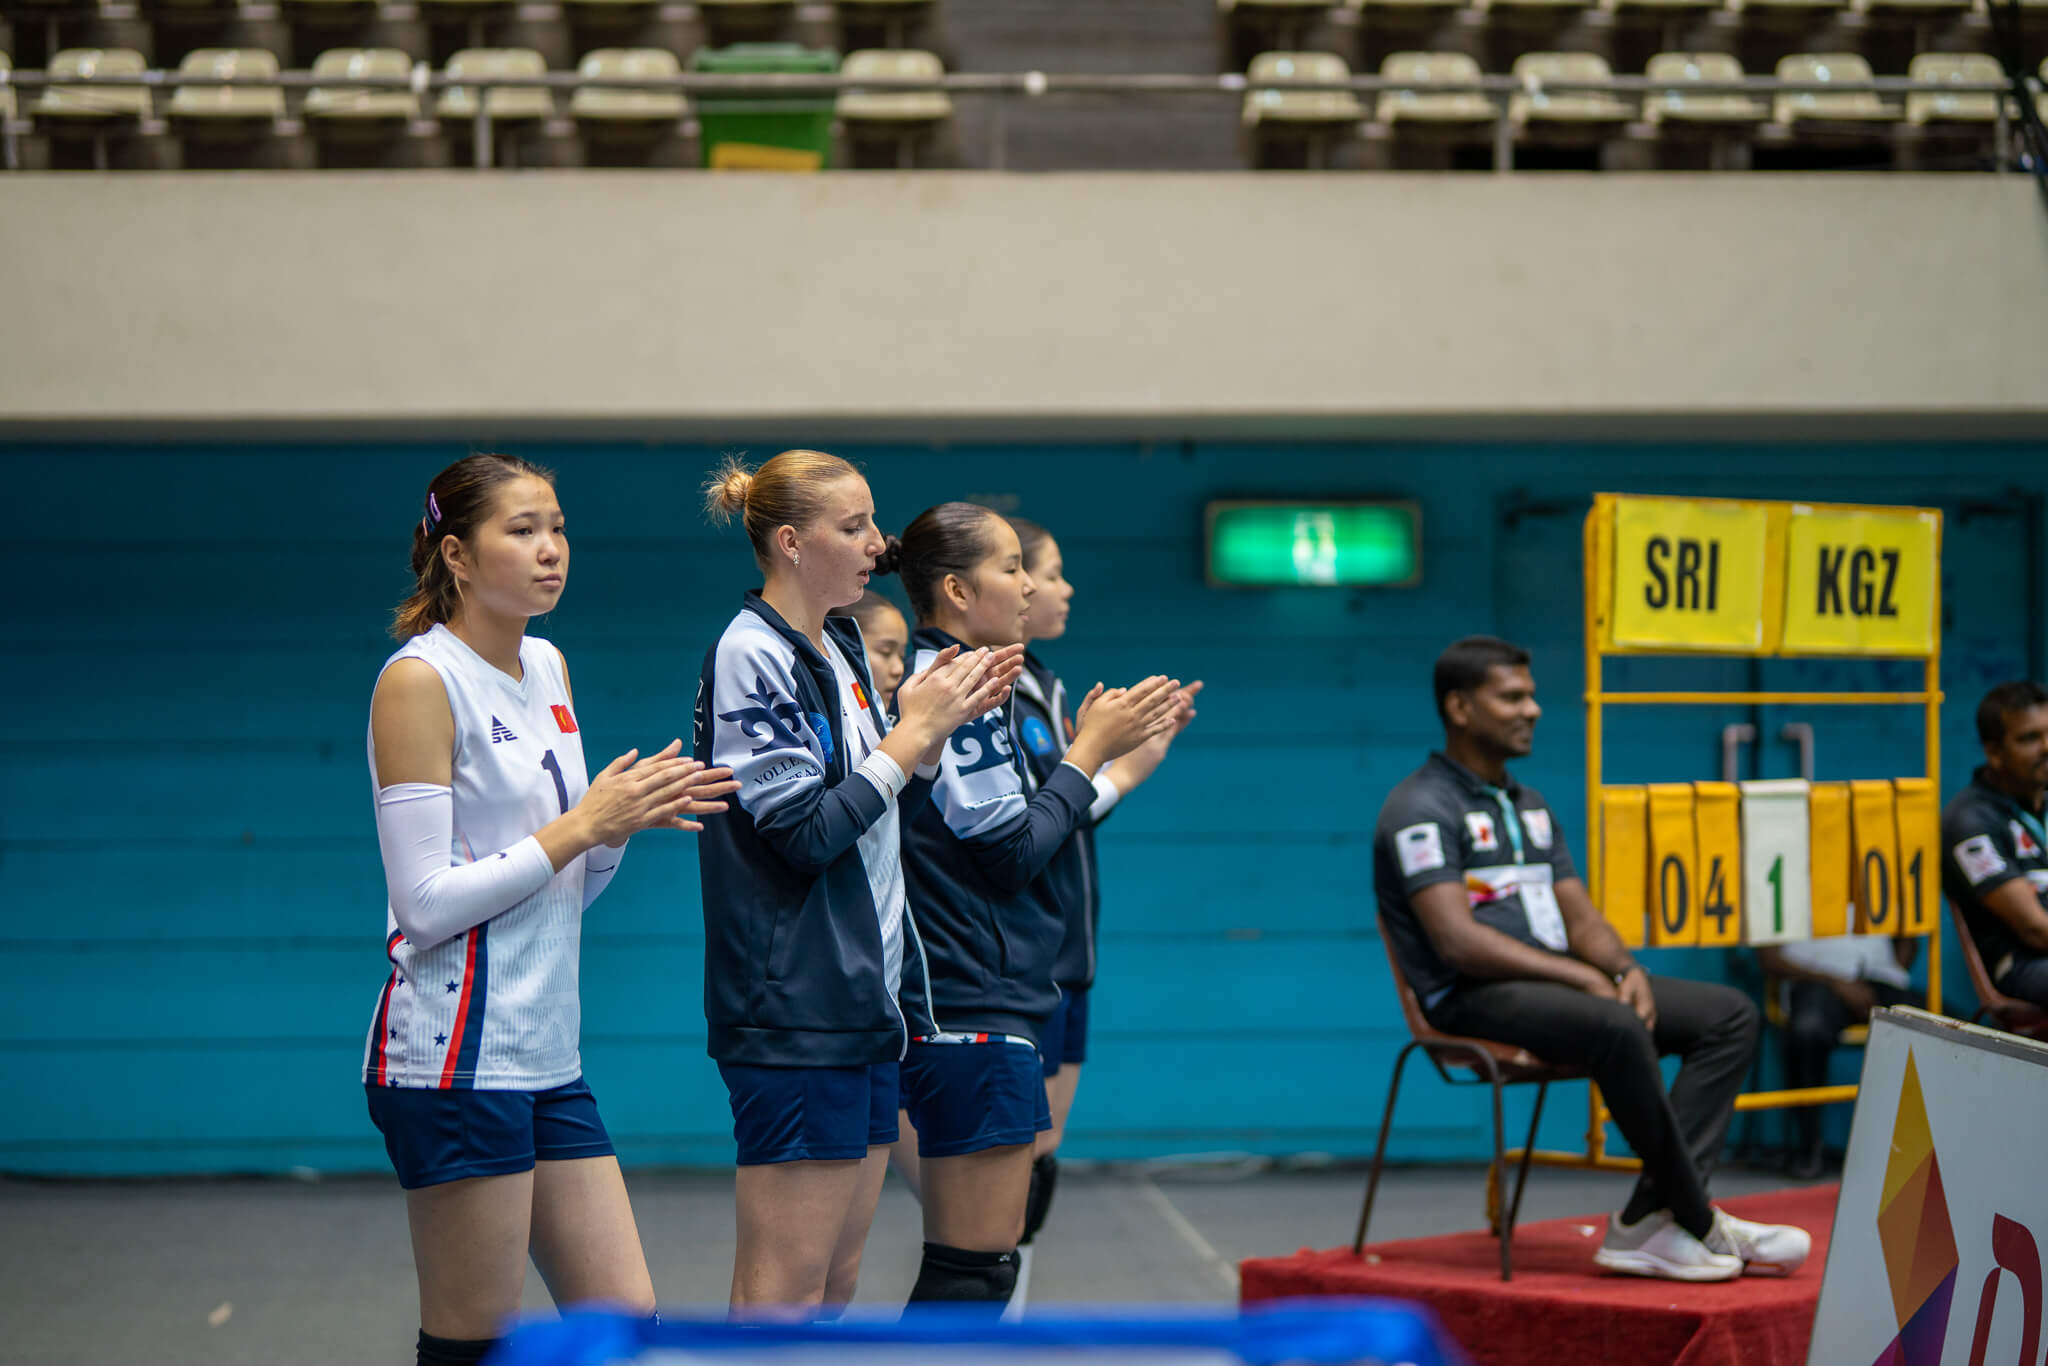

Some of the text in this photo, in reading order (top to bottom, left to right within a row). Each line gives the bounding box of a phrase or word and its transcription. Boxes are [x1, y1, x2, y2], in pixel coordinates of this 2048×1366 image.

[1645, 534, 1720, 611] SRI
[1815, 545, 1901, 617] KGZ
[541, 749, 569, 816] 1
[1767, 853, 1784, 934] 1
